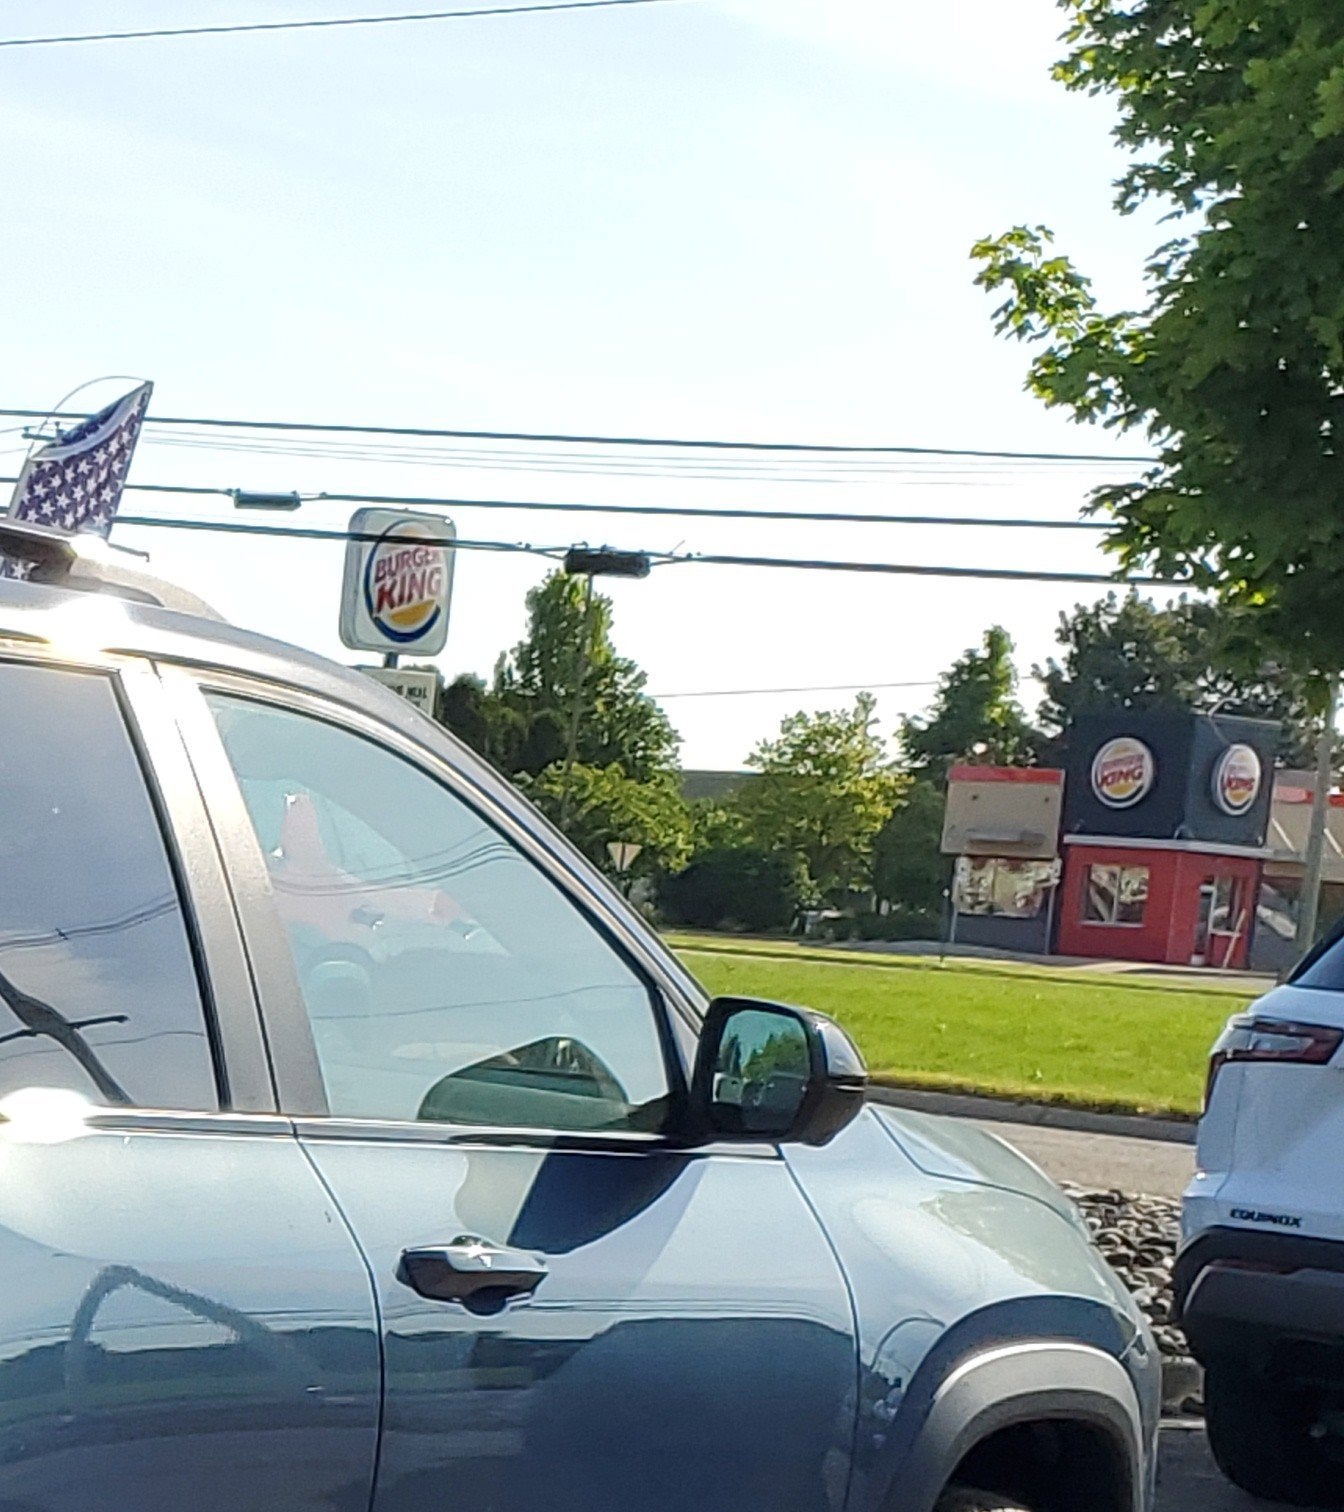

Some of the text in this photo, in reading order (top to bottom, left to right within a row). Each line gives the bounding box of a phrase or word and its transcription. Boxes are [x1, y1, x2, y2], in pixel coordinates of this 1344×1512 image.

[375, 566, 442, 614] KING
[1100, 764, 1144, 788] KING
[1230, 1208, 1302, 1228] EQUINOX
